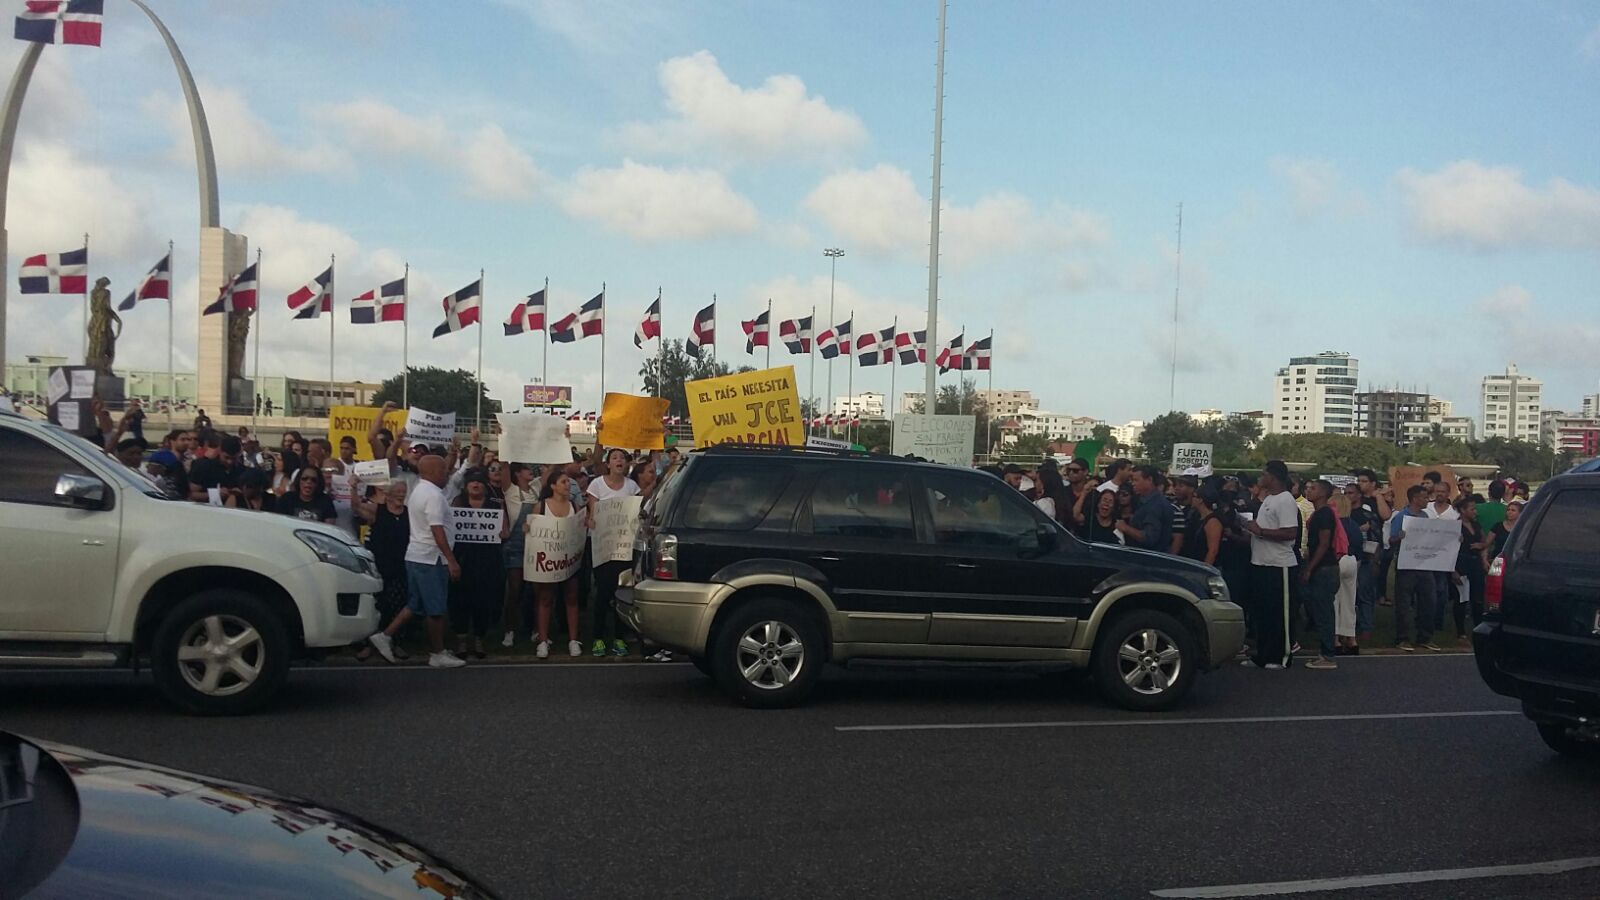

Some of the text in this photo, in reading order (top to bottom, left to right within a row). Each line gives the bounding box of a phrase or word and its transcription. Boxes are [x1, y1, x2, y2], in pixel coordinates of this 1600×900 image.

[698, 392, 713, 404] EL
[741, 377, 791, 397] NECESITA
[425, 413, 443, 422] PLD
[712, 398, 794, 428] UNA JCE
[900, 416, 974, 433] ELECCIONES
[1177, 448, 1209, 458] FUERA
[1176, 457, 1209, 466] ROBERTO
[453, 510, 499, 519] SOY VOZ
[455, 521, 496, 531] QUE NO
[454, 533, 489, 542] CALLA
